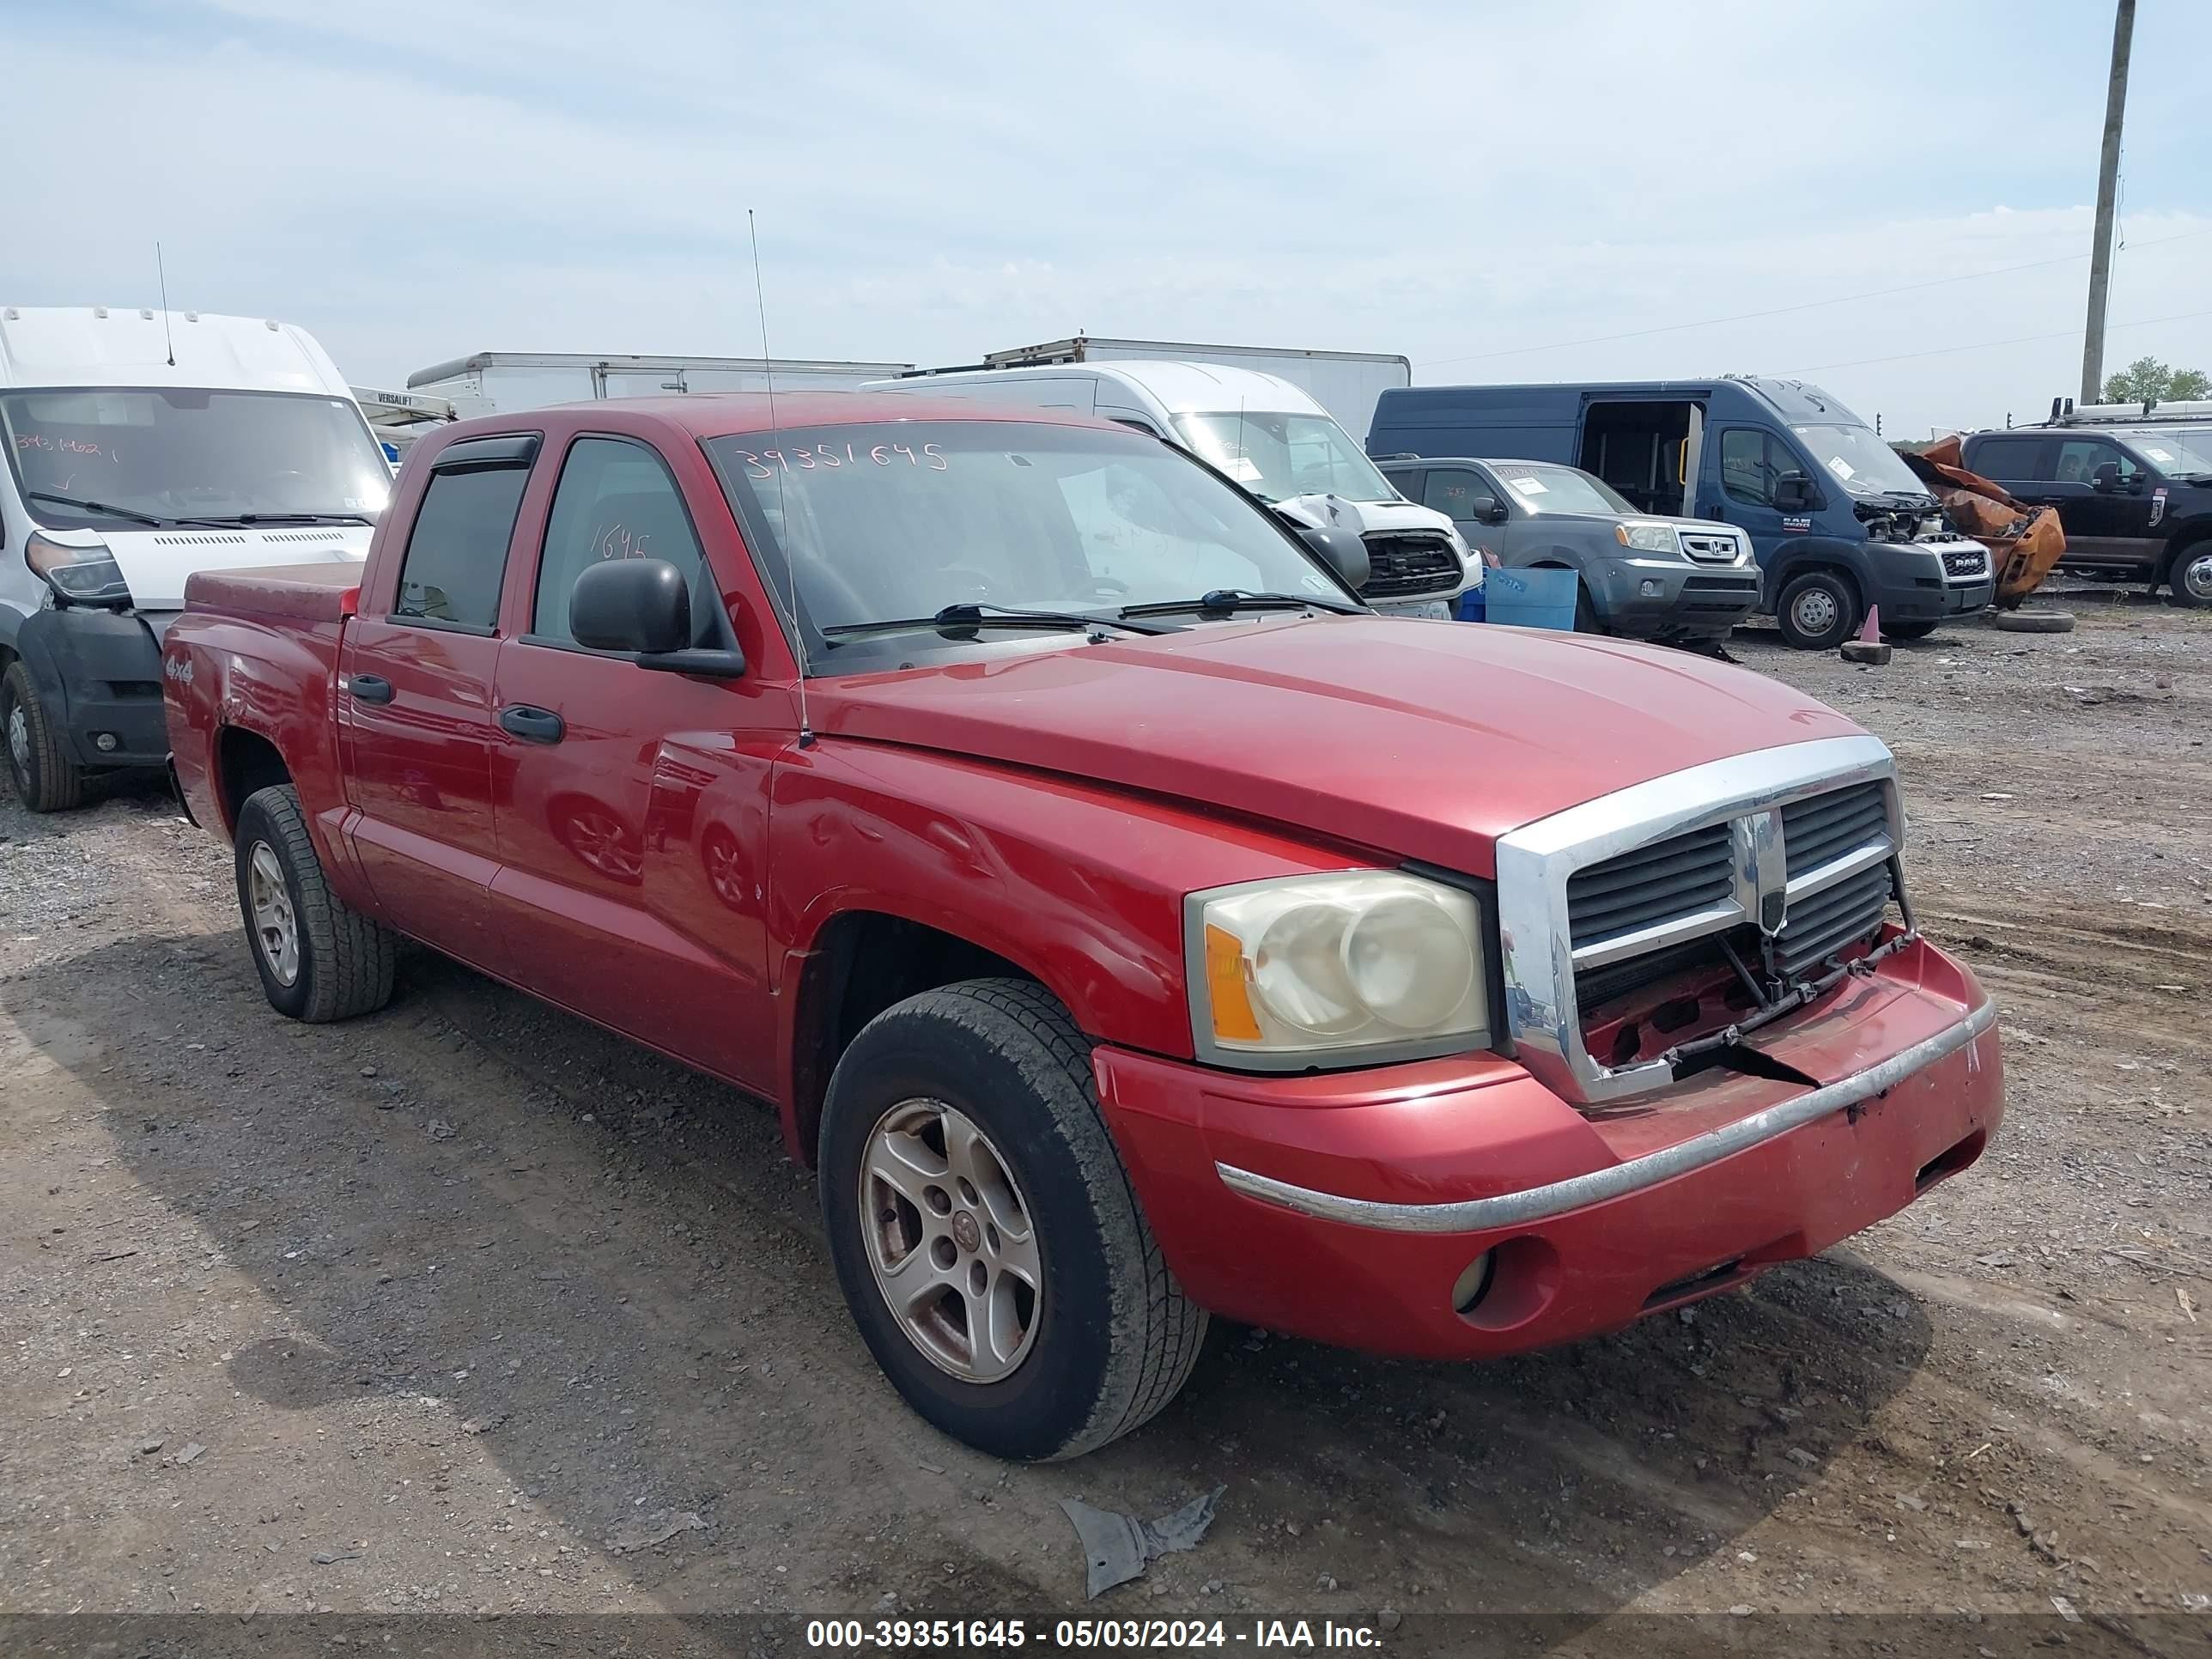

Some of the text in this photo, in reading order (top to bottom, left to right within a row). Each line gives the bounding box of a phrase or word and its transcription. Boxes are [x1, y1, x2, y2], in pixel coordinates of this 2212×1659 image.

[378, 392, 413, 406] VERSALIFT
[734, 443, 947, 478] 39351645
[1955, 558, 1978, 568] RAM
